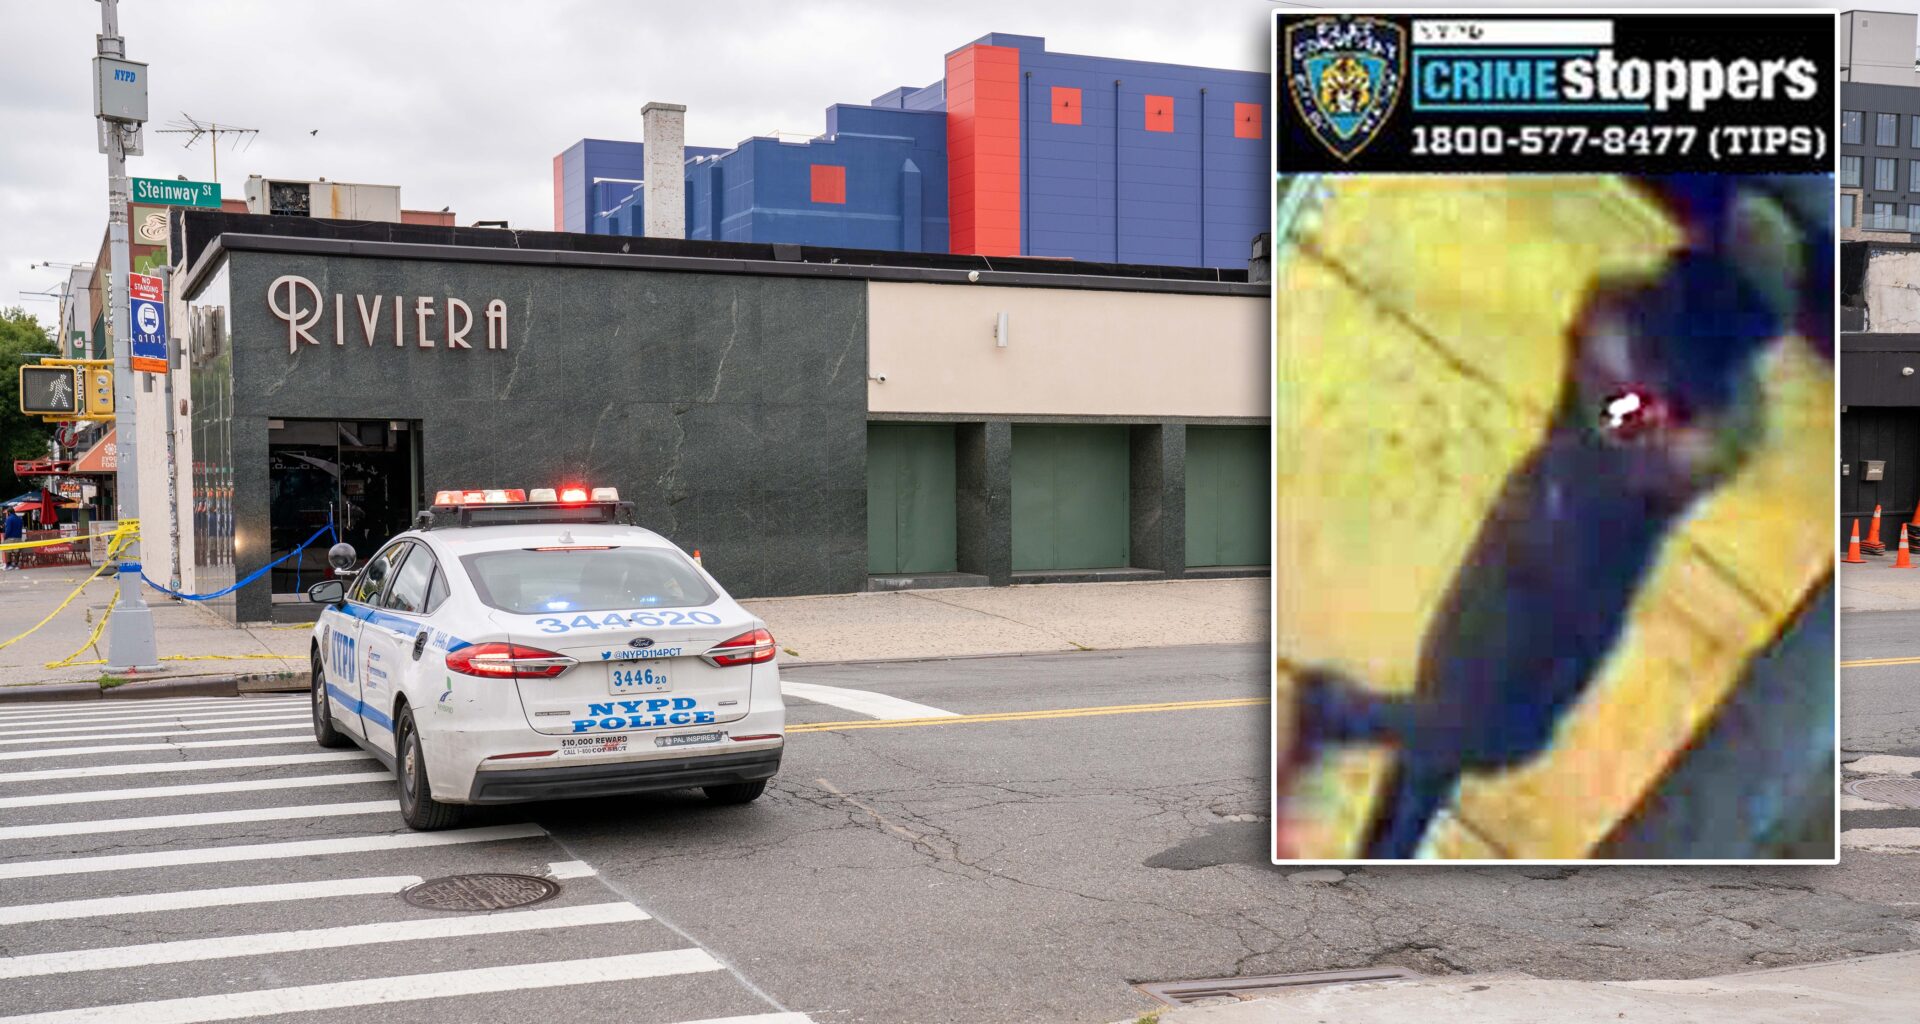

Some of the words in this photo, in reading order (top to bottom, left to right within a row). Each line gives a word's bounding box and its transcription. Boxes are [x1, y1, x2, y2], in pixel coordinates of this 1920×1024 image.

[114, 69, 136, 83] NYPD
[138, 180, 199, 205] Steinway
[202, 184, 212, 196] St
[134, 282, 159, 293] STANDING
[141, 276, 151, 285] NO
[267, 275, 508, 354] RIVIERA
[535, 611, 722, 633] 344620
[633, 639, 650, 648] Ford
[332, 629, 355, 684] NYPD
[614, 647, 682, 659] @NYPD114PCT
[613, 669, 653, 687] 3446
[654, 676, 667, 685] 20
[588, 697, 697, 717] NYPD
[571, 711, 715, 733] POLICE
[561, 738, 594, 747] $10,000
[595, 735, 628, 744] REWARD
[686, 734, 716, 743] INSPIRES
